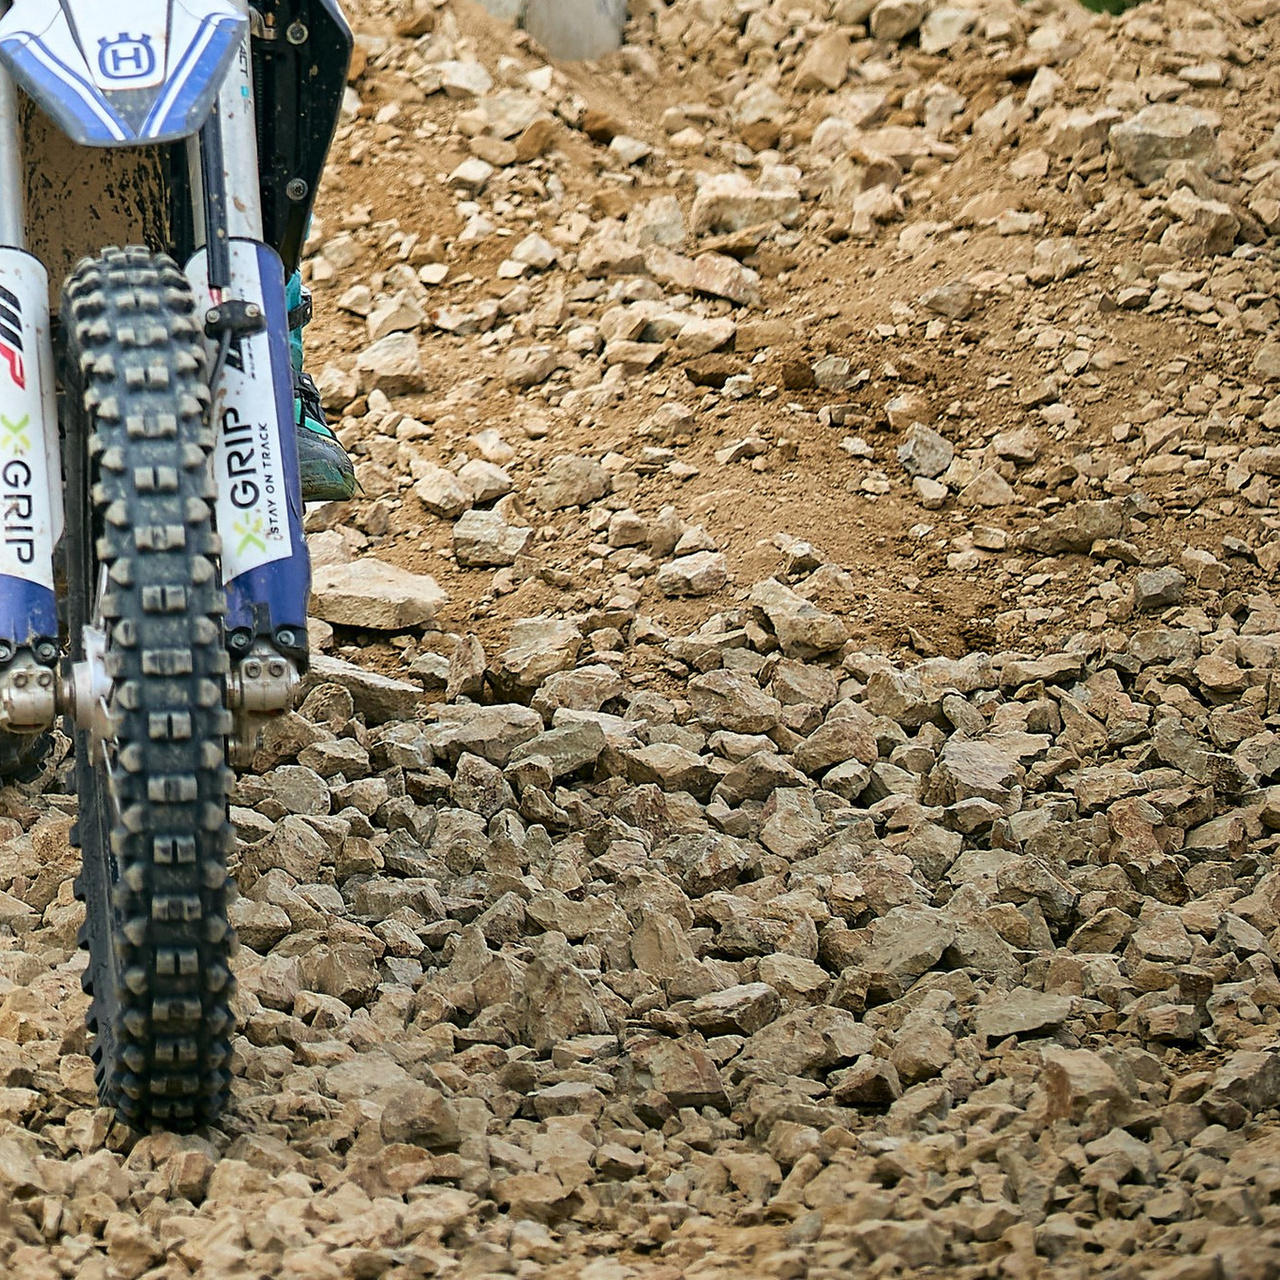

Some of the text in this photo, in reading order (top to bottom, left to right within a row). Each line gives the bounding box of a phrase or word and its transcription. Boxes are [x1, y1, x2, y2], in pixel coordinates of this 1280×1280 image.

[0, 412, 34, 566] X-GRIP
[222, 406, 267, 558] X-GRIP
[258, 421, 281, 535] STAY ON TRACK
